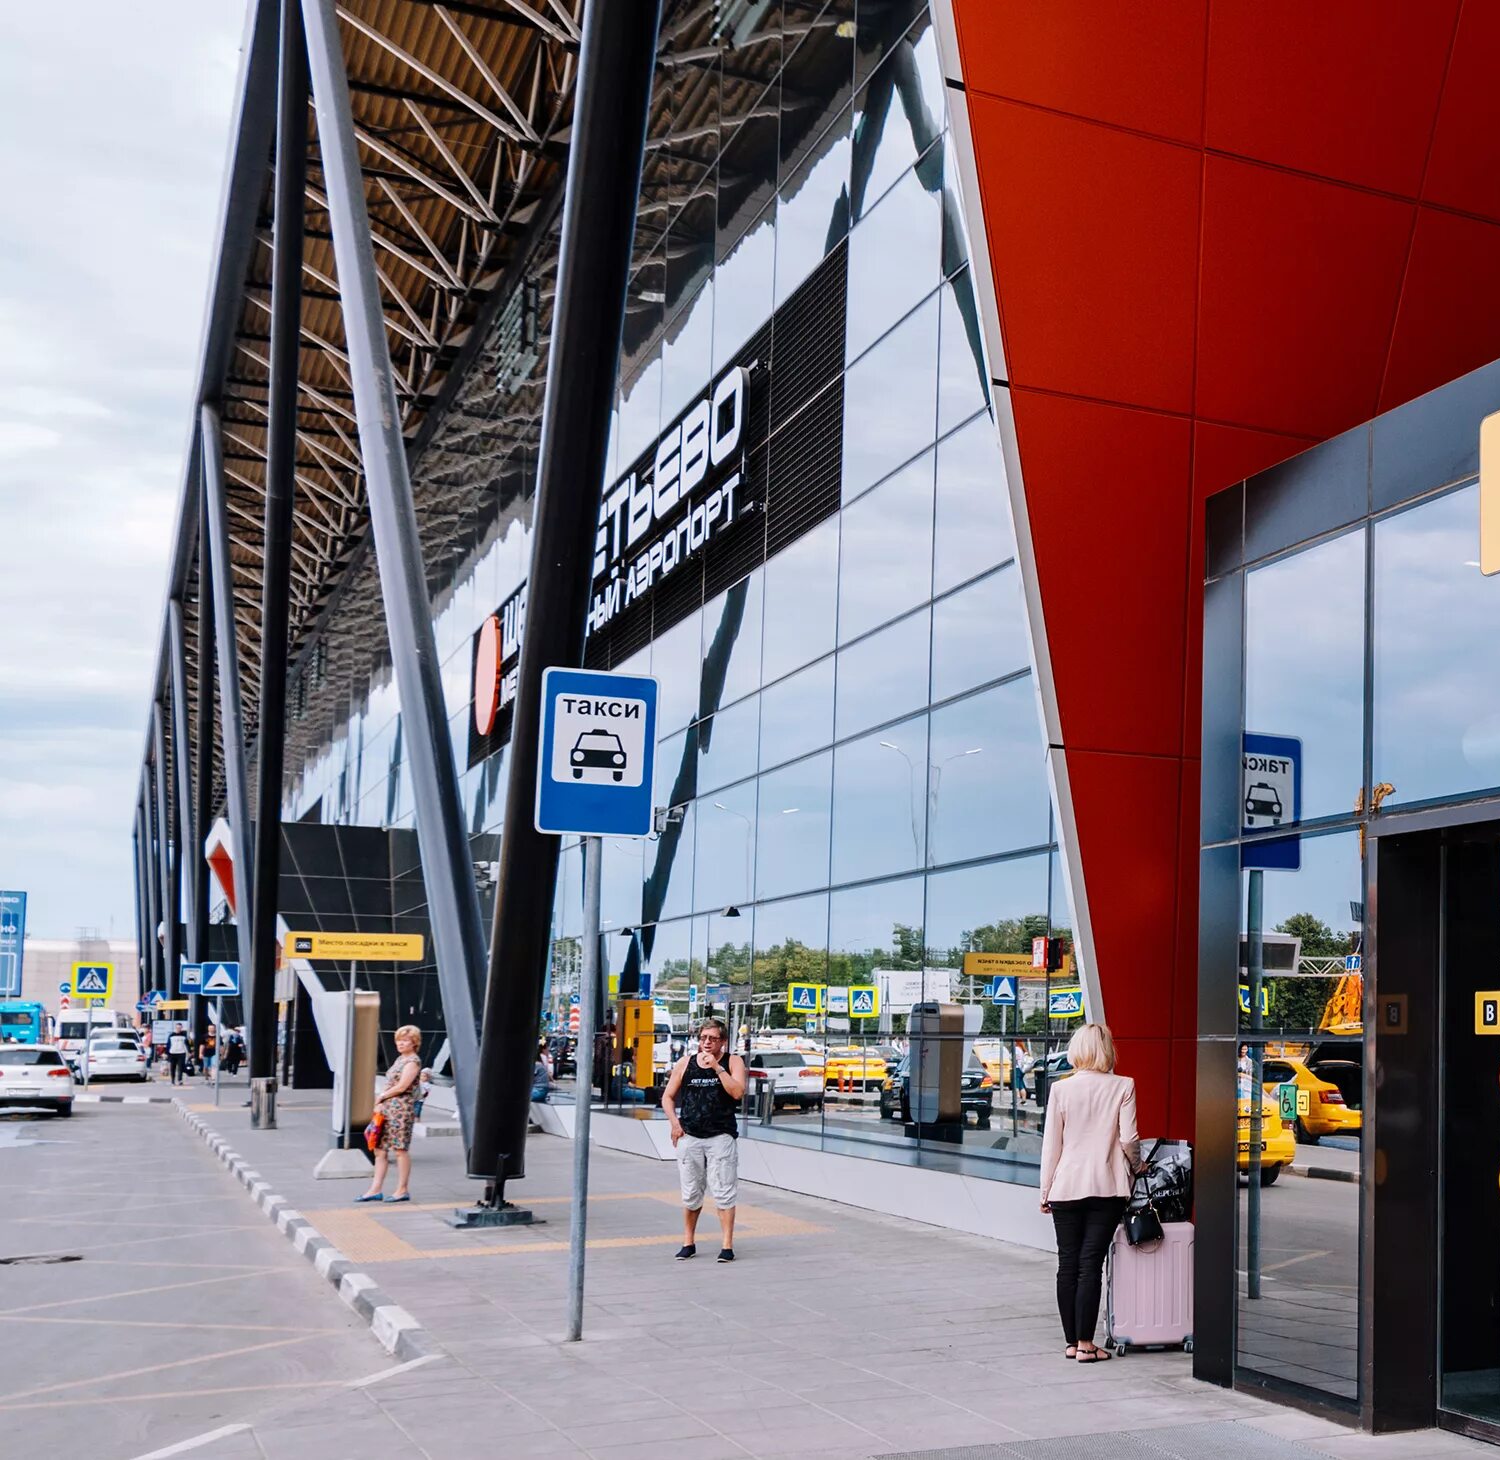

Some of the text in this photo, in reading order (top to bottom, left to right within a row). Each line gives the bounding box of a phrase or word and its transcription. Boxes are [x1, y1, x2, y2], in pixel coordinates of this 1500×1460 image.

[625, 473, 740, 606] АЭРОПОРТ
[563, 698, 640, 719] такси
[1486, 1004, 1495, 1021] B
